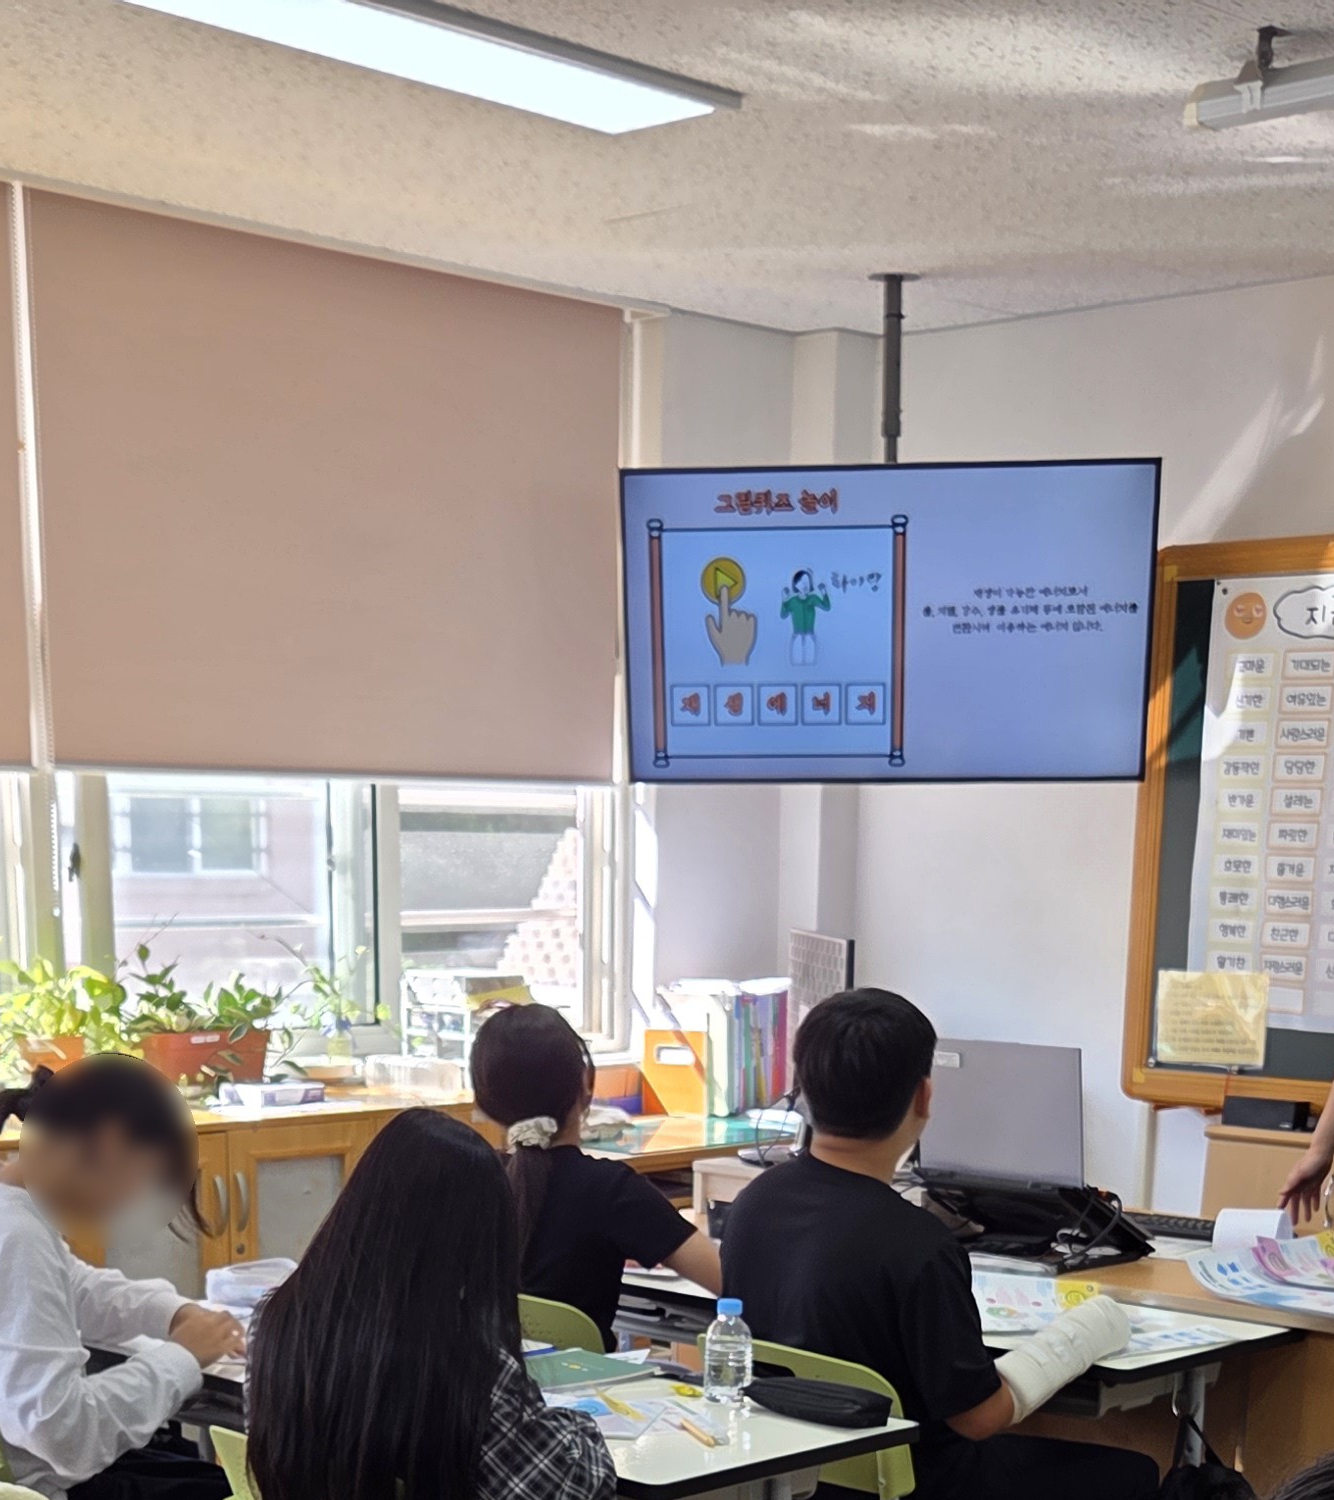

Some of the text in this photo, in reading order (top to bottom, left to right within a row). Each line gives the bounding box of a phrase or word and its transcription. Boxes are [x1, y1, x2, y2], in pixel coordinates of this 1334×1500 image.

[714, 488, 838, 515] 그림퀴즈 놀이
[1291, 658, 1331, 673] 기대되는
[1286, 693, 1328, 707] 여유있는
[1280, 728, 1325, 742] 사랑스러운
[1223, 761, 1260, 776] 감동적인
[1284, 760, 1316, 775] 당당한
[1228, 794, 1254, 808] 반가운
[1283, 794, 1314, 808] 설레는
[1222, 828, 1256, 842] 재미있는
[1278, 828, 1309, 842] 짜릿한
[1277, 862, 1305, 877] 즐거운
[1268, 895, 1310, 910] 다행스러운
[1219, 923, 1246, 938] 행복한
[1270, 927, 1299, 942] 친근한
[1217, 955, 1246, 969] 활기찬
[1264, 959, 1303, 975] 자랑스러운
